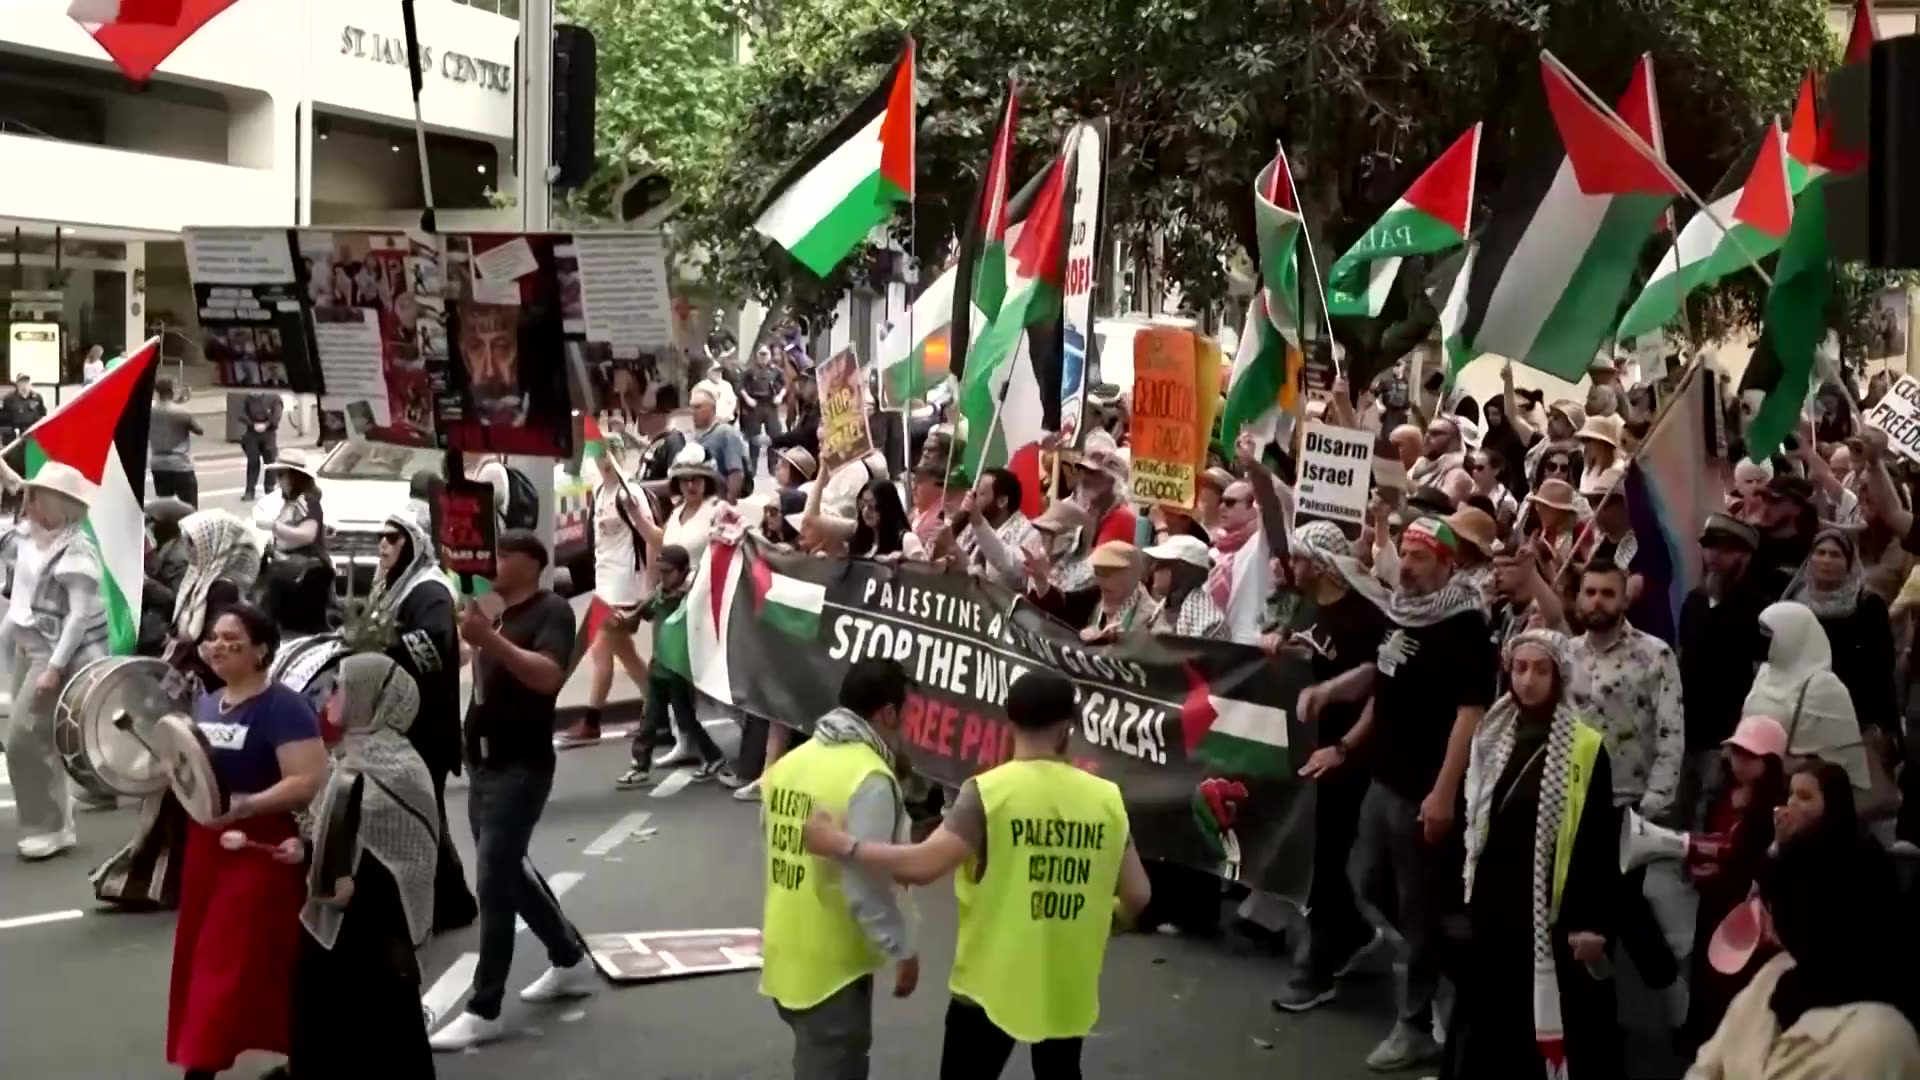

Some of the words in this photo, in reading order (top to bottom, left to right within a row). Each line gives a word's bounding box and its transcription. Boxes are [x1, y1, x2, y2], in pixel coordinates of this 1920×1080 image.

[371, 33, 432, 72] JAMS
[441, 50, 511, 93] CENTRE
[1306, 432, 1368, 460] Disarm
[1302, 460, 1354, 488] Israel
[1299, 497, 1362, 518] Palestinians
[864, 578, 981, 632] PALESTINE
[829, 615, 913, 664] STOP
[916, 633, 972, 694] THE
[1082, 691, 1167, 765] GAZA!
[903, 692, 959, 758] REE
[1011, 818, 1106, 850] PALESTINE
